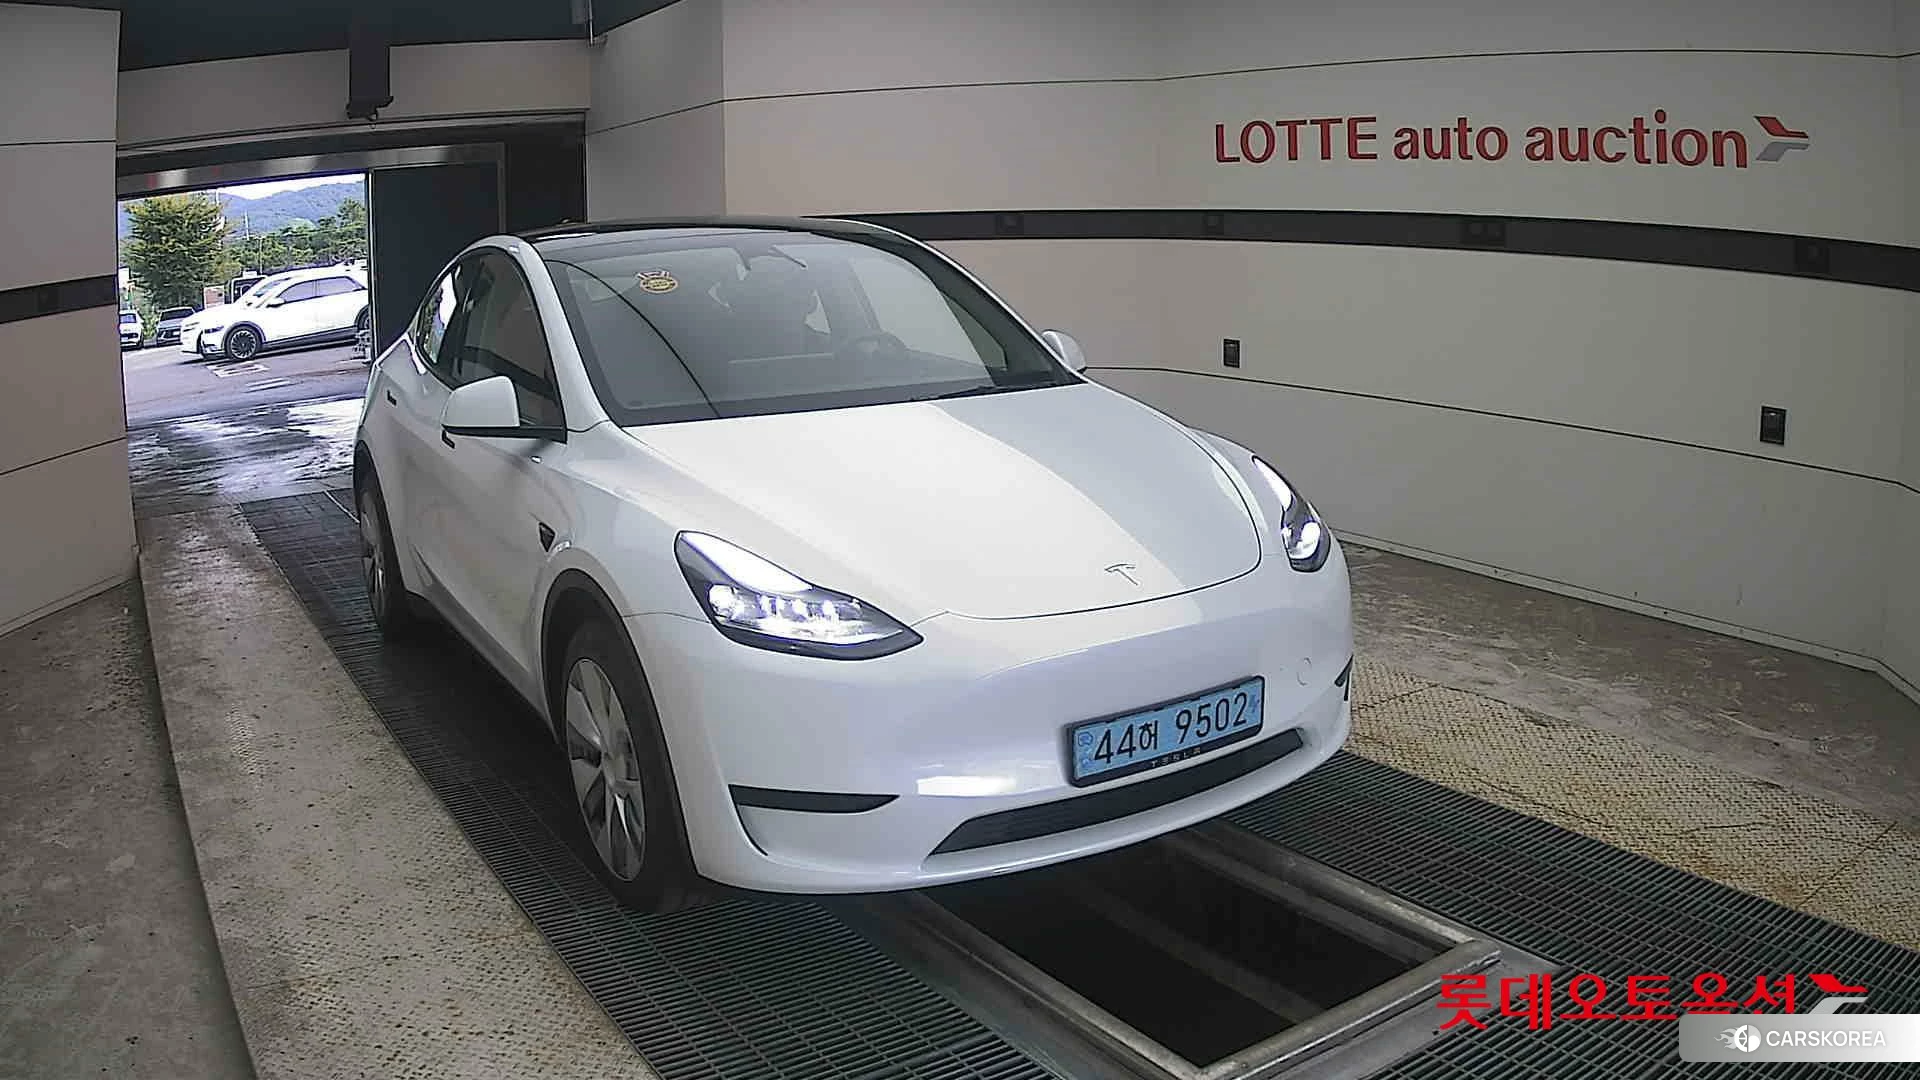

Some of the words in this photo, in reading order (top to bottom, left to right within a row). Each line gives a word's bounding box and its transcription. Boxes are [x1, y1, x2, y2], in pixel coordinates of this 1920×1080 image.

[1215, 116, 1378, 163] LOTTE
[1393, 117, 1509, 161] auto
[1524, 109, 1748, 169] auction
[1094, 718, 1159, 764] 44허
[1175, 691, 1249, 745] 9502
